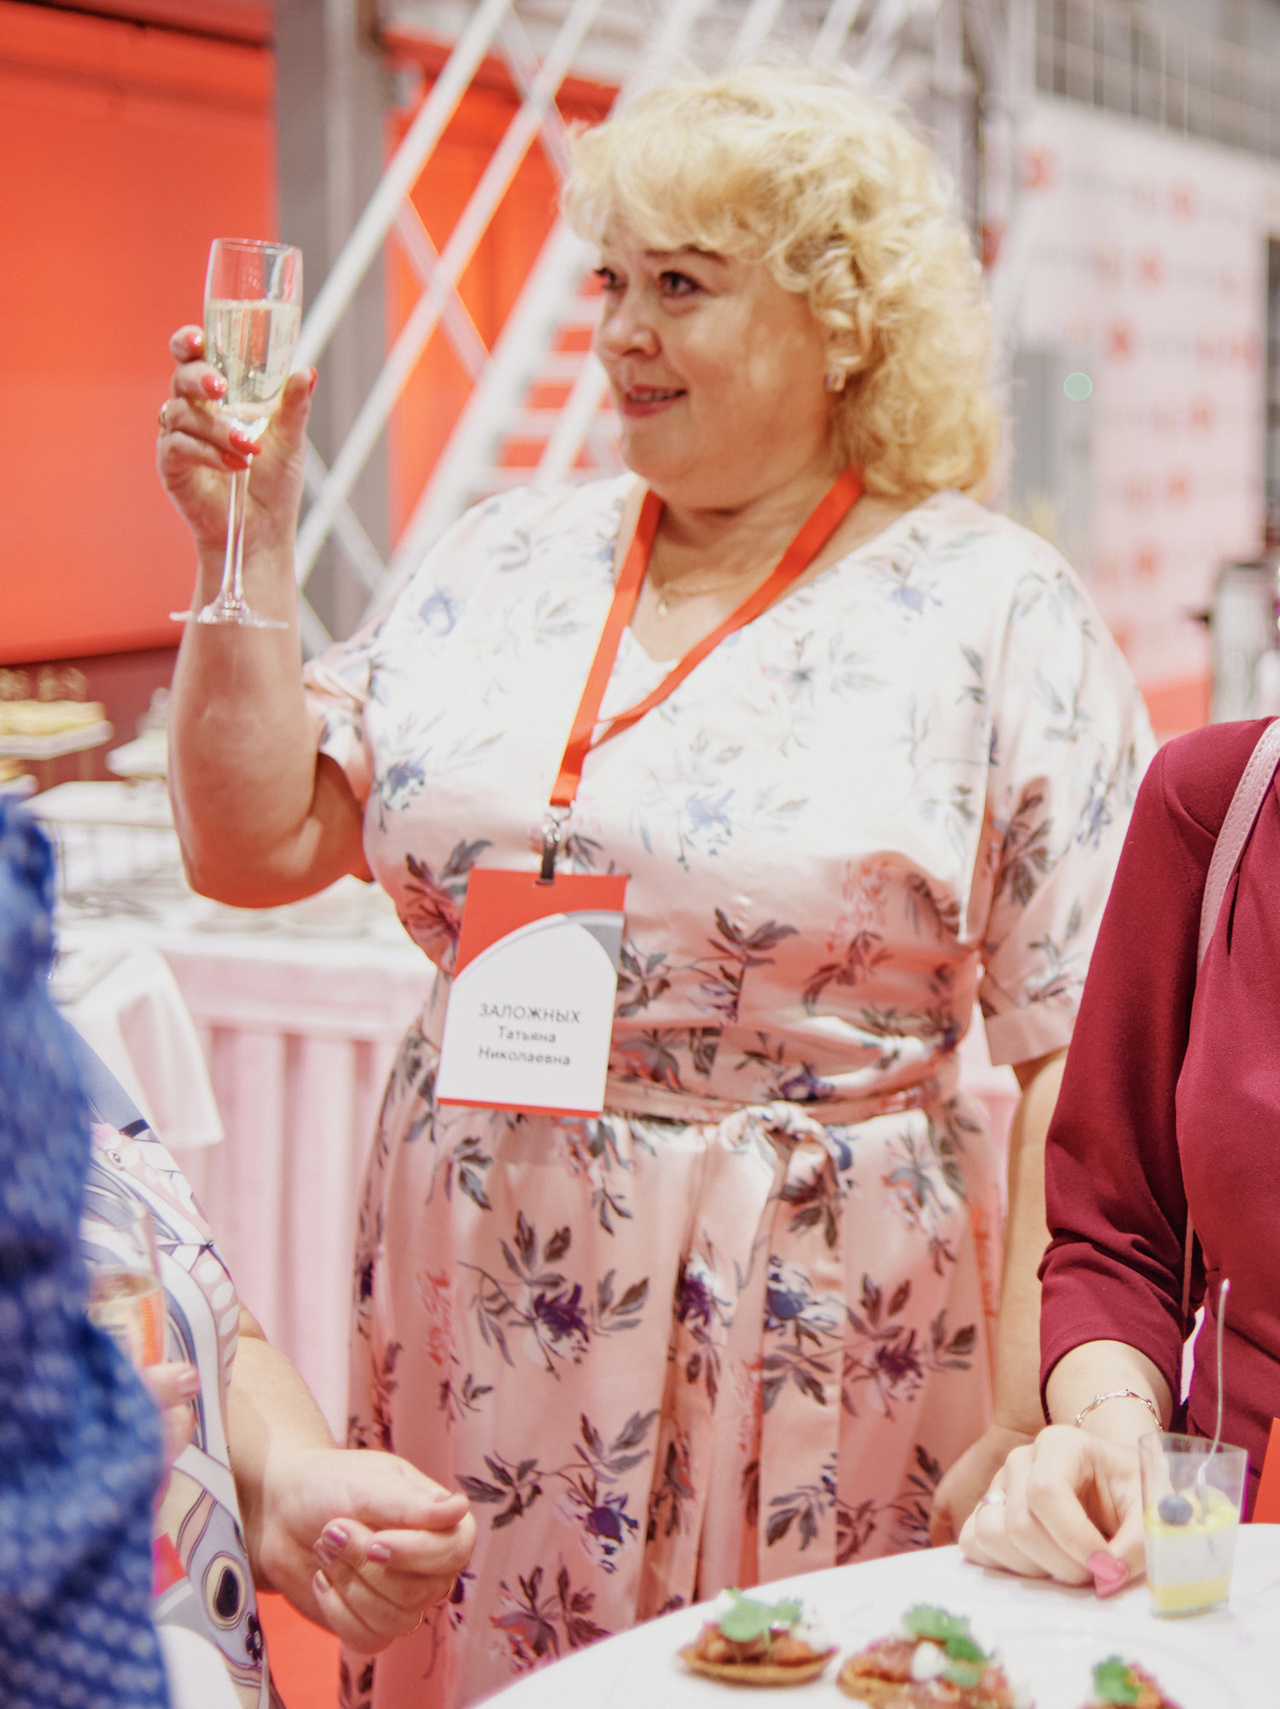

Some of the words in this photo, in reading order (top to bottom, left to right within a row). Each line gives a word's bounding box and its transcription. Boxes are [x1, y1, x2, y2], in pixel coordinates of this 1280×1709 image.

[479, 1003, 581, 1023] ЗАЛОЖНЫХ
[498, 1025, 556, 1043] Татьяна
[478, 1046, 571, 1066] Николаевна
